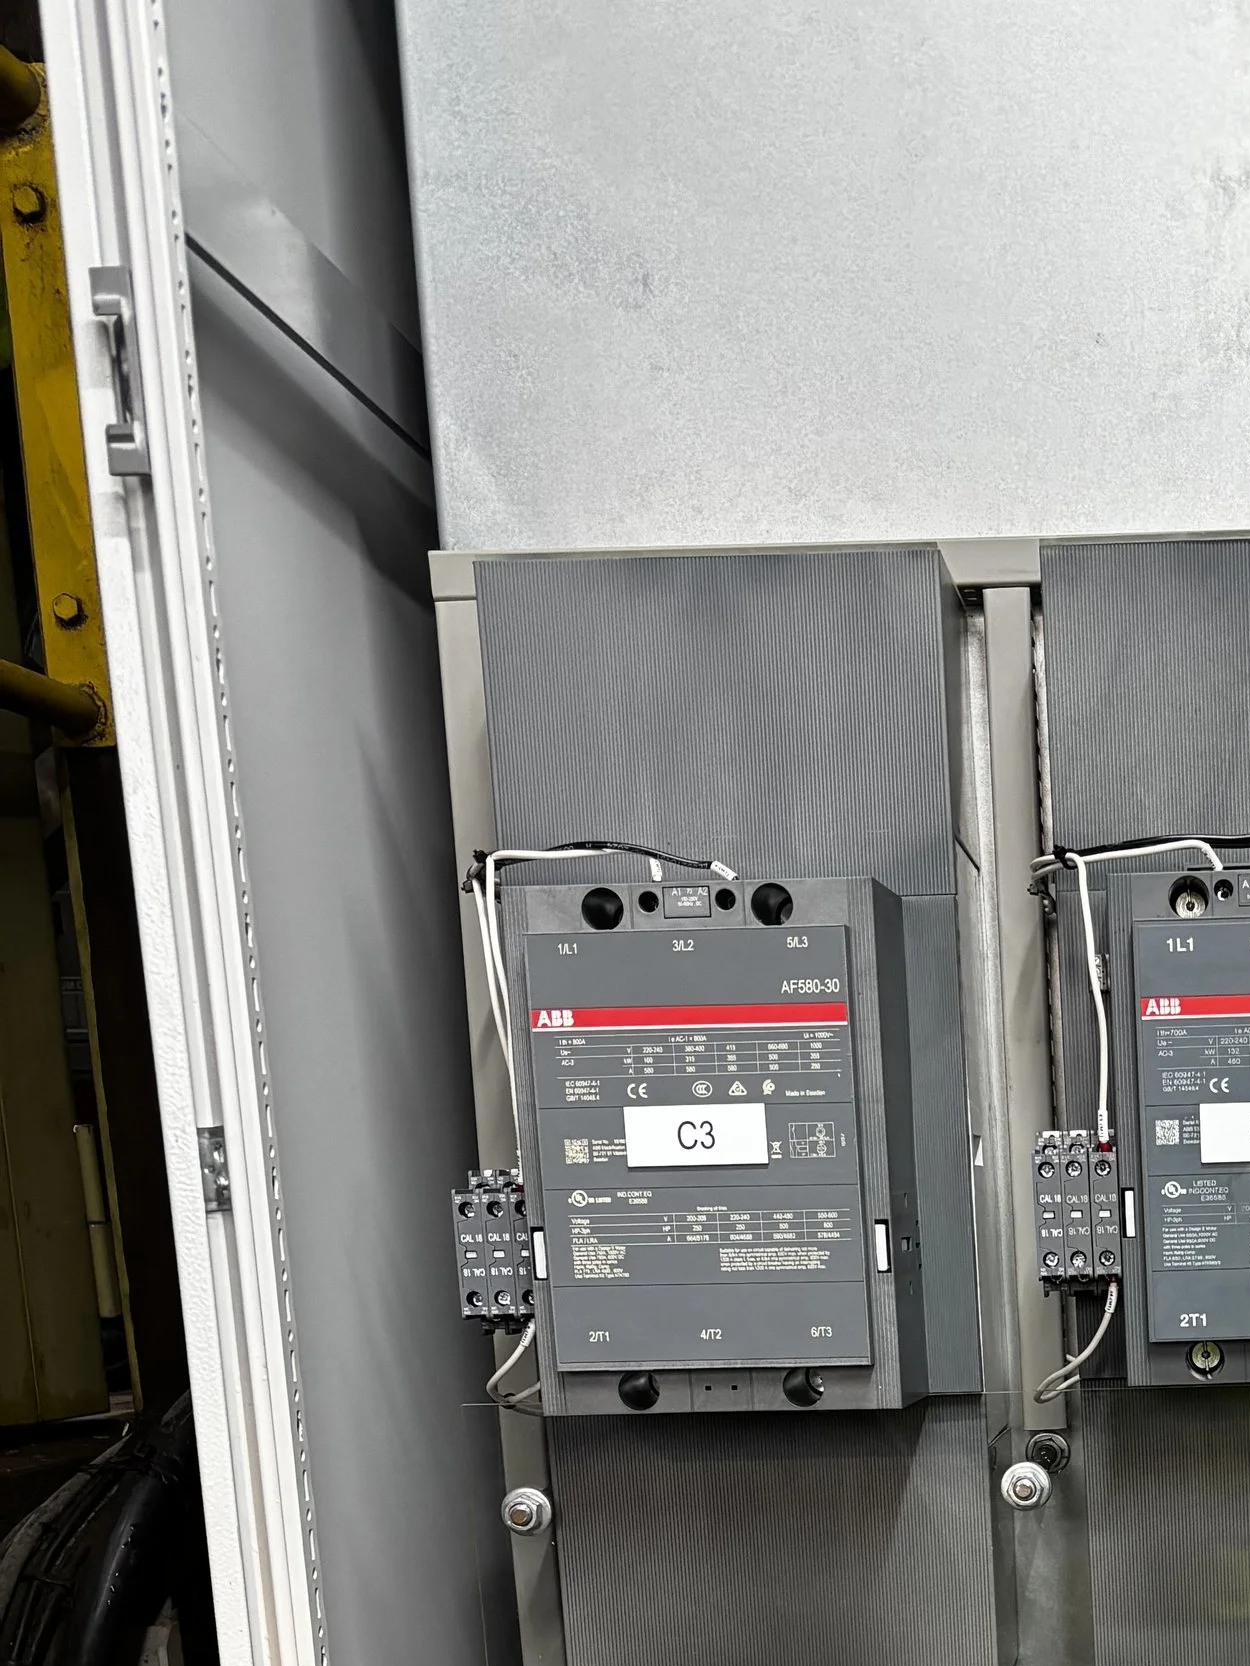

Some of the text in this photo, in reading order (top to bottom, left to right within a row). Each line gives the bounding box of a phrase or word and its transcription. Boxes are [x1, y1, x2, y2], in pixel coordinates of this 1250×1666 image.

[672, 886, 708, 896] A1 A2
[672, 939, 694, 952] 3/L2
[786, 936, 808, 948] 5/L3
[1166, 938, 1194, 952] 1L1
[557, 943, 578, 955] 1/L1
[781, 979, 839, 994] AF580-30
[1146, 998, 1182, 1015] ABB
[537, 1010, 574, 1027] ABB
[1220, 1037, 1248, 1045] 220-240
[677, 1120, 716, 1150] C3
[1039, 1194, 1053, 1203] CAL
[1066, 1195, 1079, 1203] CAL
[1095, 1194, 1107, 1202] CAL
[571, 1218, 590, 1226] Voltage
[1050, 1228, 1063, 1237] CAL
[1077, 1226, 1090, 1235] CAL
[1105, 1225, 1119, 1234] CAL
[460, 1234, 474, 1243] CAL
[488, 1234, 501, 1242] CAL
[472, 1268, 486, 1276] CAL
[500, 1268, 513, 1276] CAL
[1179, 1313, 1207, 1328] 2T1
[589, 1331, 610, 1343] 2/T1
[700, 1329, 722, 1340] 4/T2
[811, 1326, 832, 1338] 6/T3
